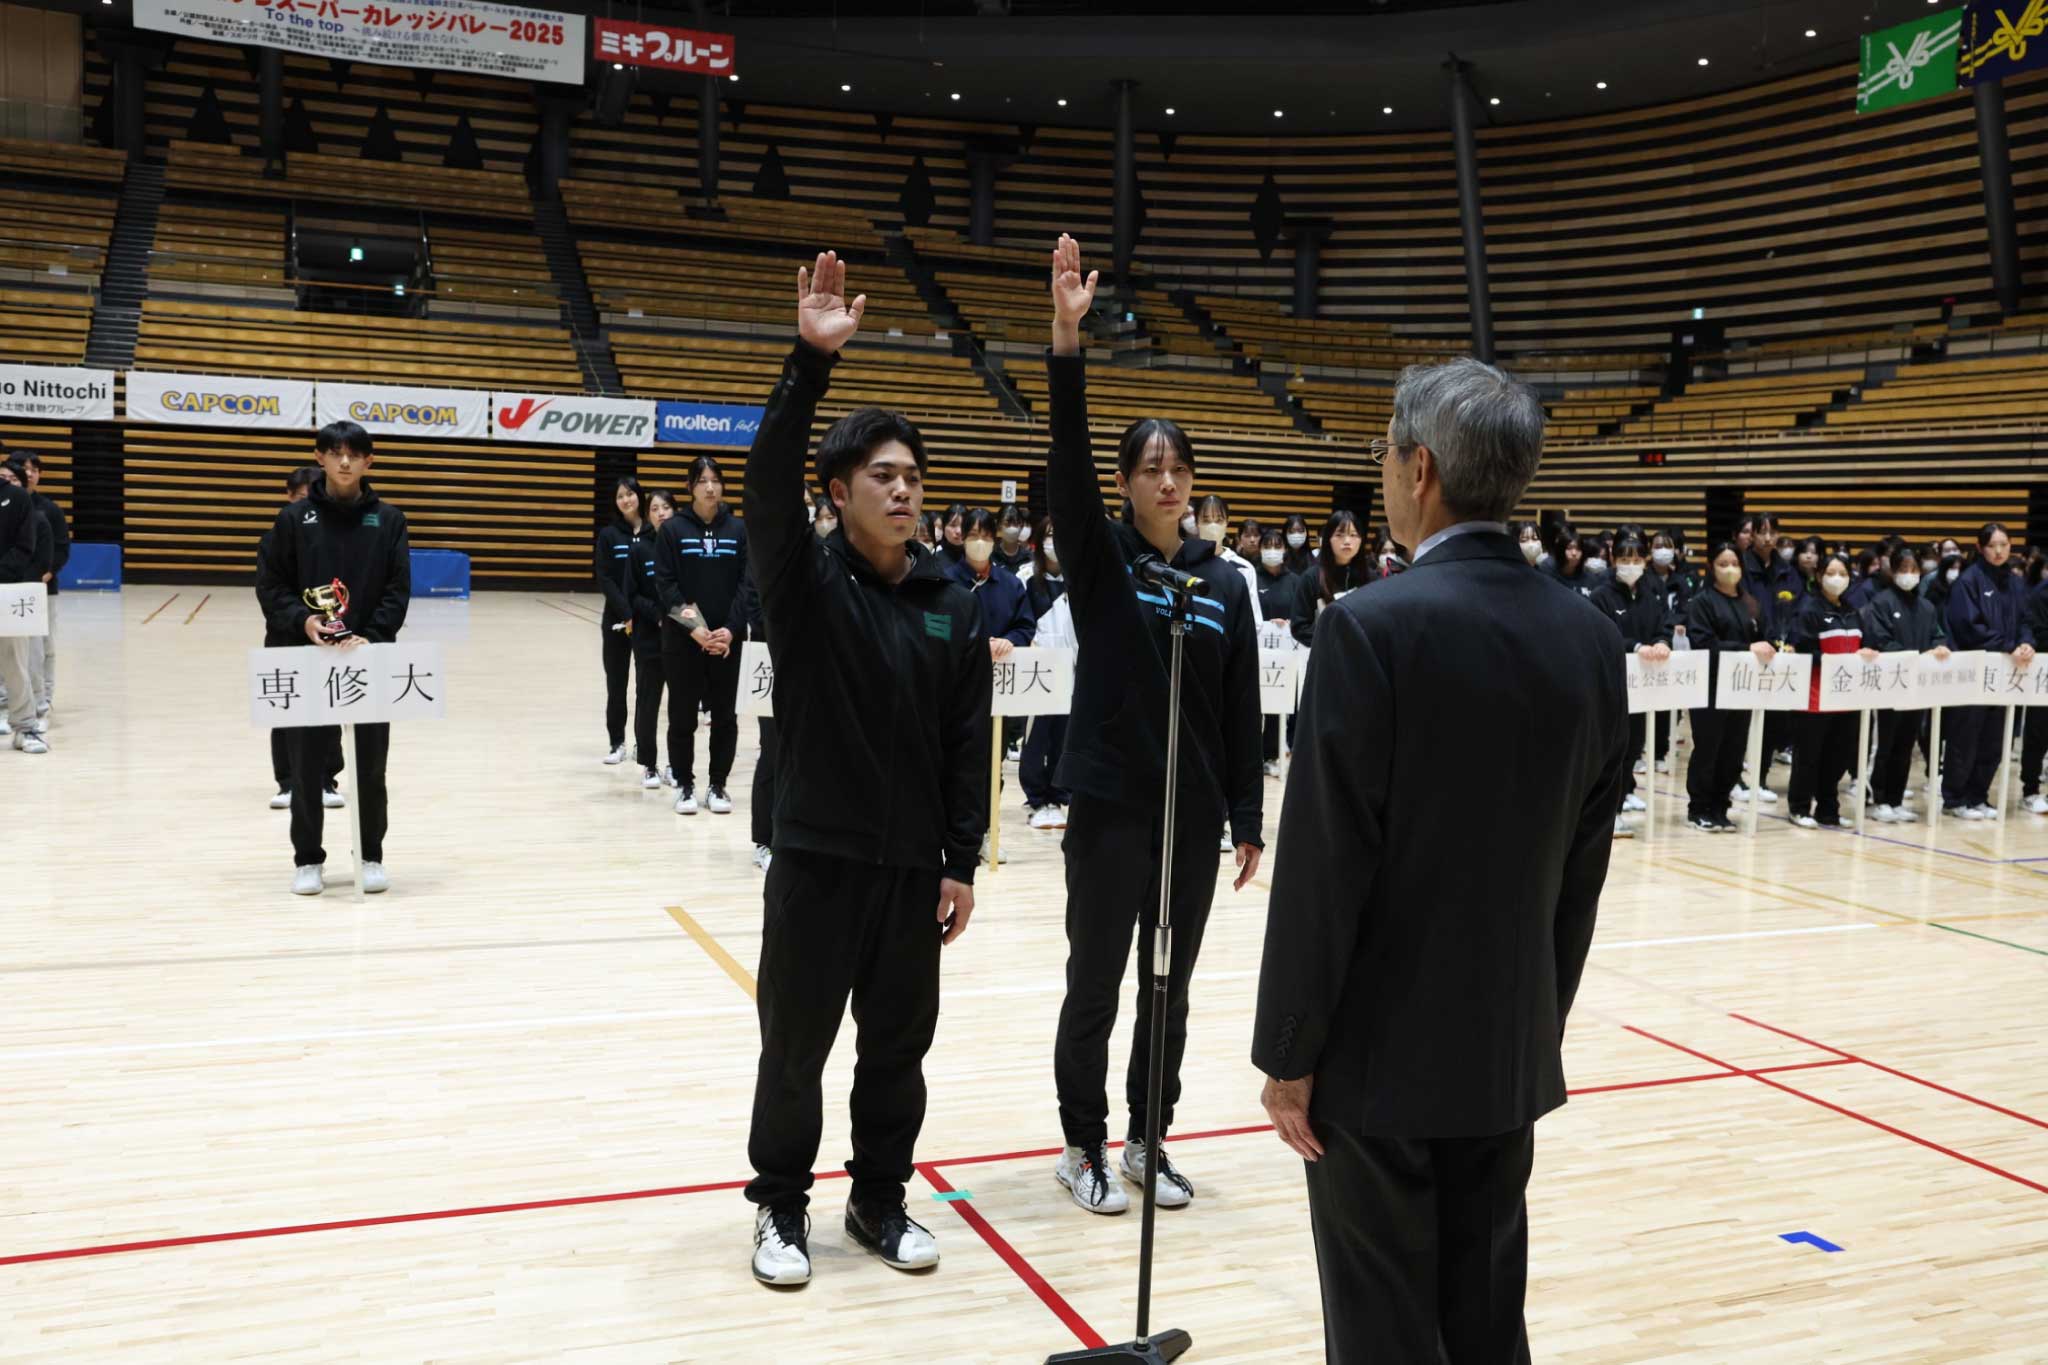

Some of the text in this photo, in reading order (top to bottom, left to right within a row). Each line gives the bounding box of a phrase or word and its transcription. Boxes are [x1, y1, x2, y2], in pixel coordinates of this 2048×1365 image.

[264, 7, 344, 34] To the top
[601, 31, 729, 69] ミキプルーン
[23, 379, 107, 400] Nittochi
[161, 390, 280, 416] CAPCOM
[349, 401, 458, 426] CAPCOM
[539, 410, 650, 437] POWER
[664, 414, 732, 432] molten
[11, 596, 36, 618] ポ
[256, 662, 434, 711] 専修大
[1259, 660, 1285, 688] 立
[1731, 661, 1798, 693] 仙台大
[1831, 663, 1909, 694] 金城大
